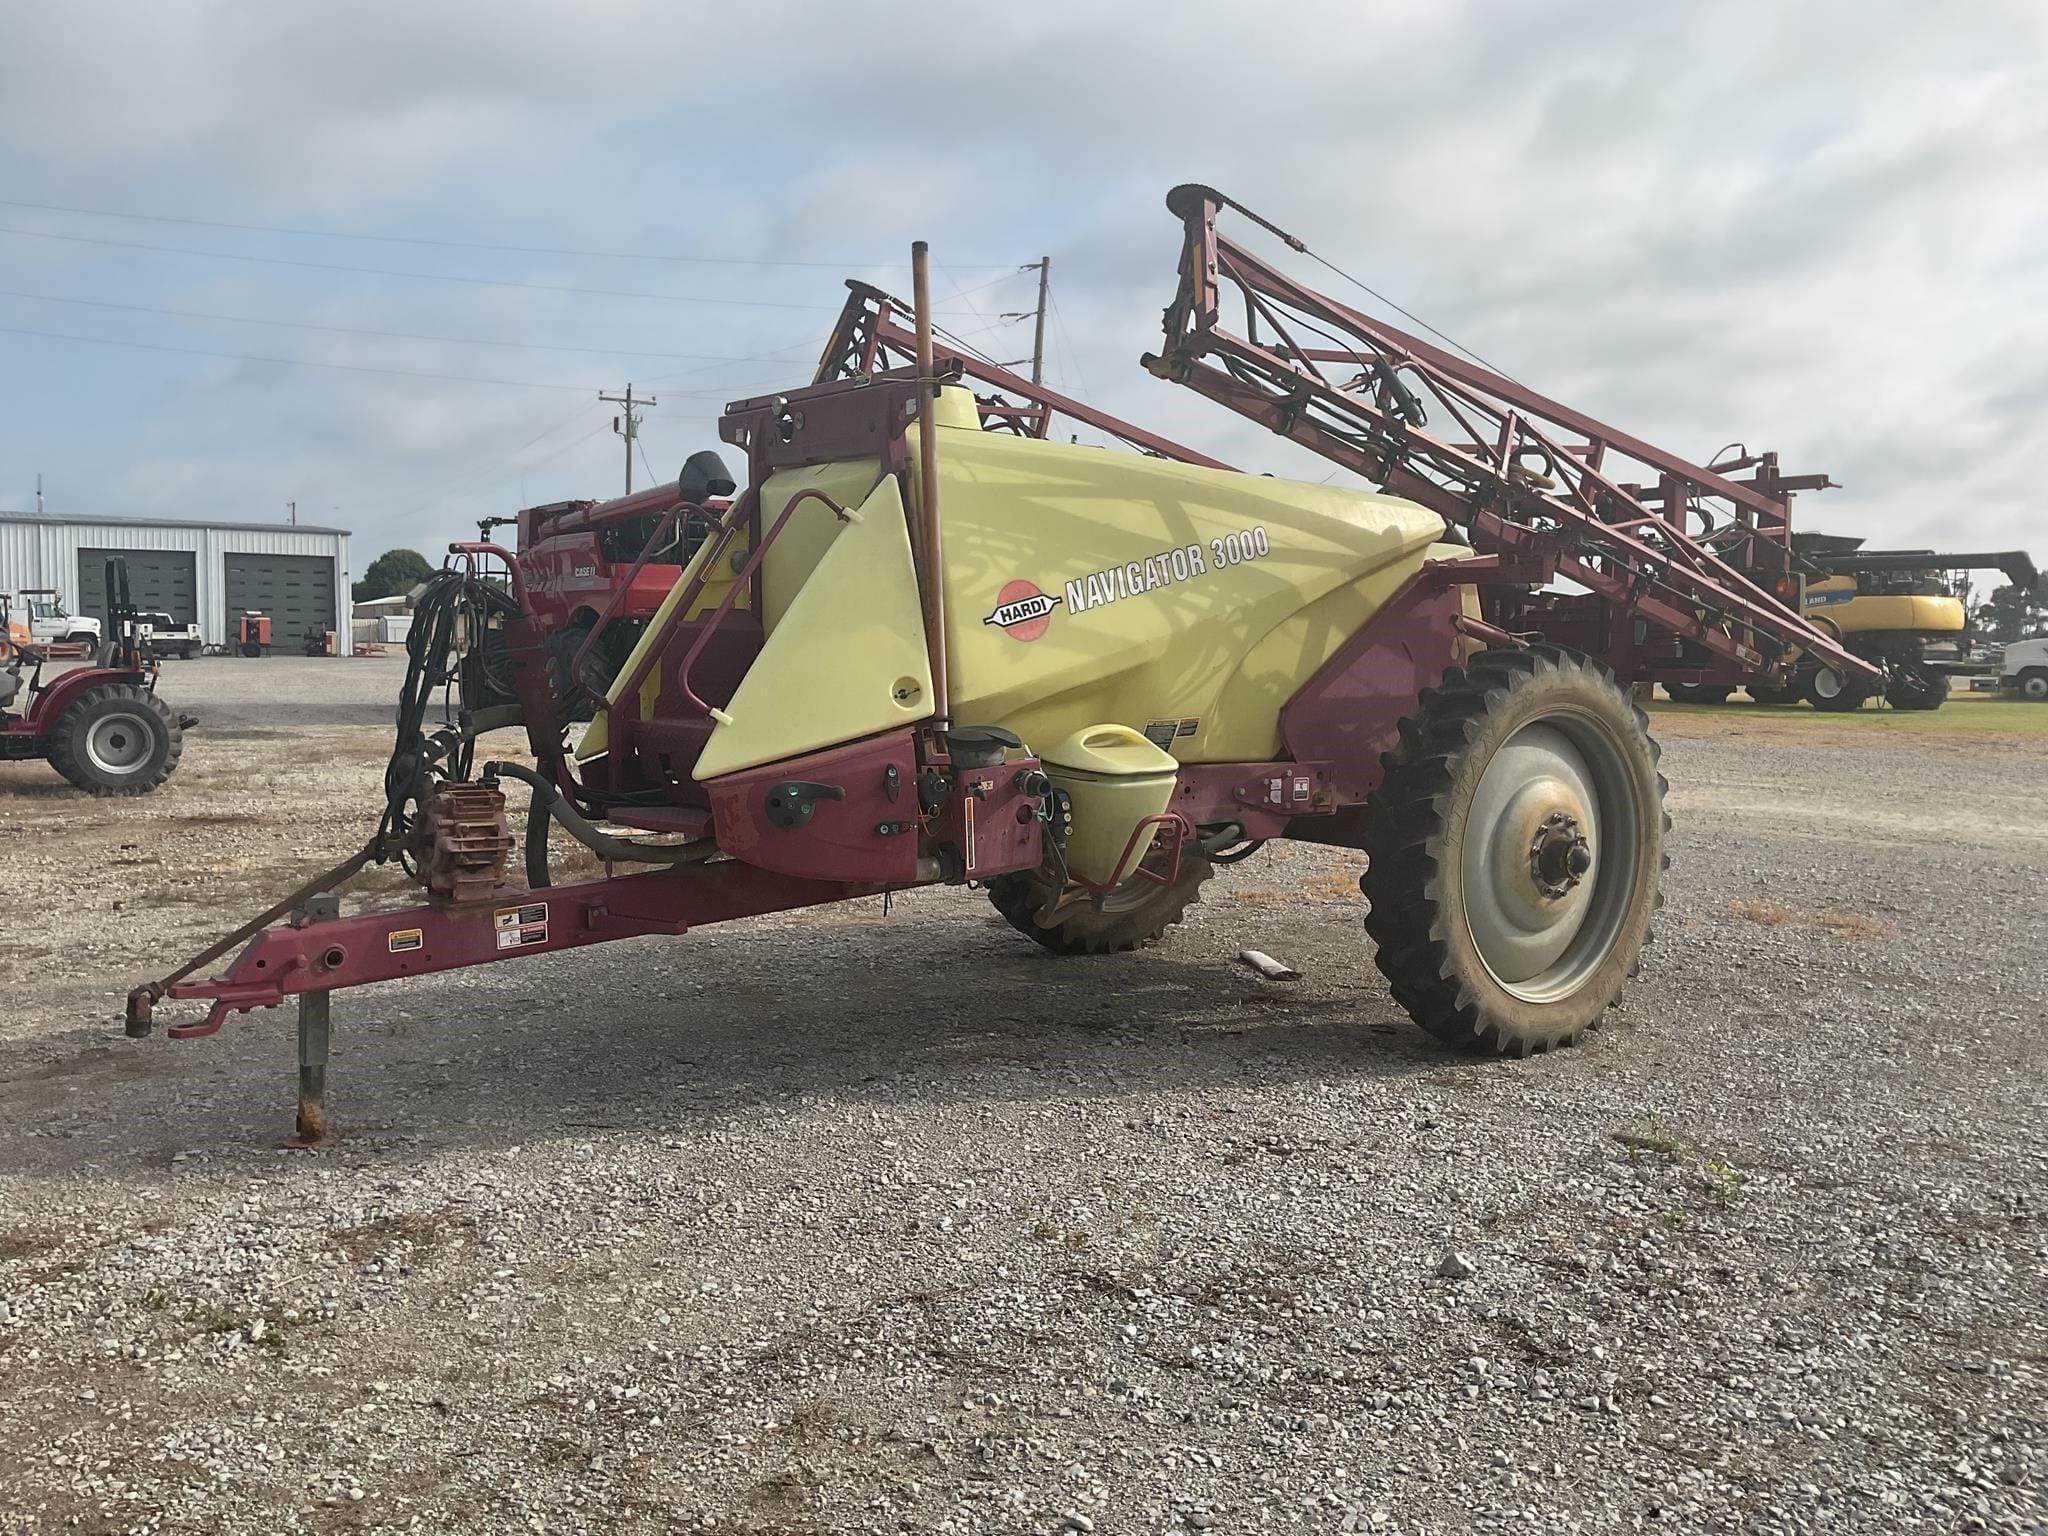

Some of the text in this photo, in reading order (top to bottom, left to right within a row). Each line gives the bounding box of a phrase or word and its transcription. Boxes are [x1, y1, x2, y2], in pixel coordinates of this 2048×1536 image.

[575, 566, 590, 577] CASE
[1065, 526, 1270, 614] NAVIGATOR 3000
[1000, 598, 1047, 623] HARDI
